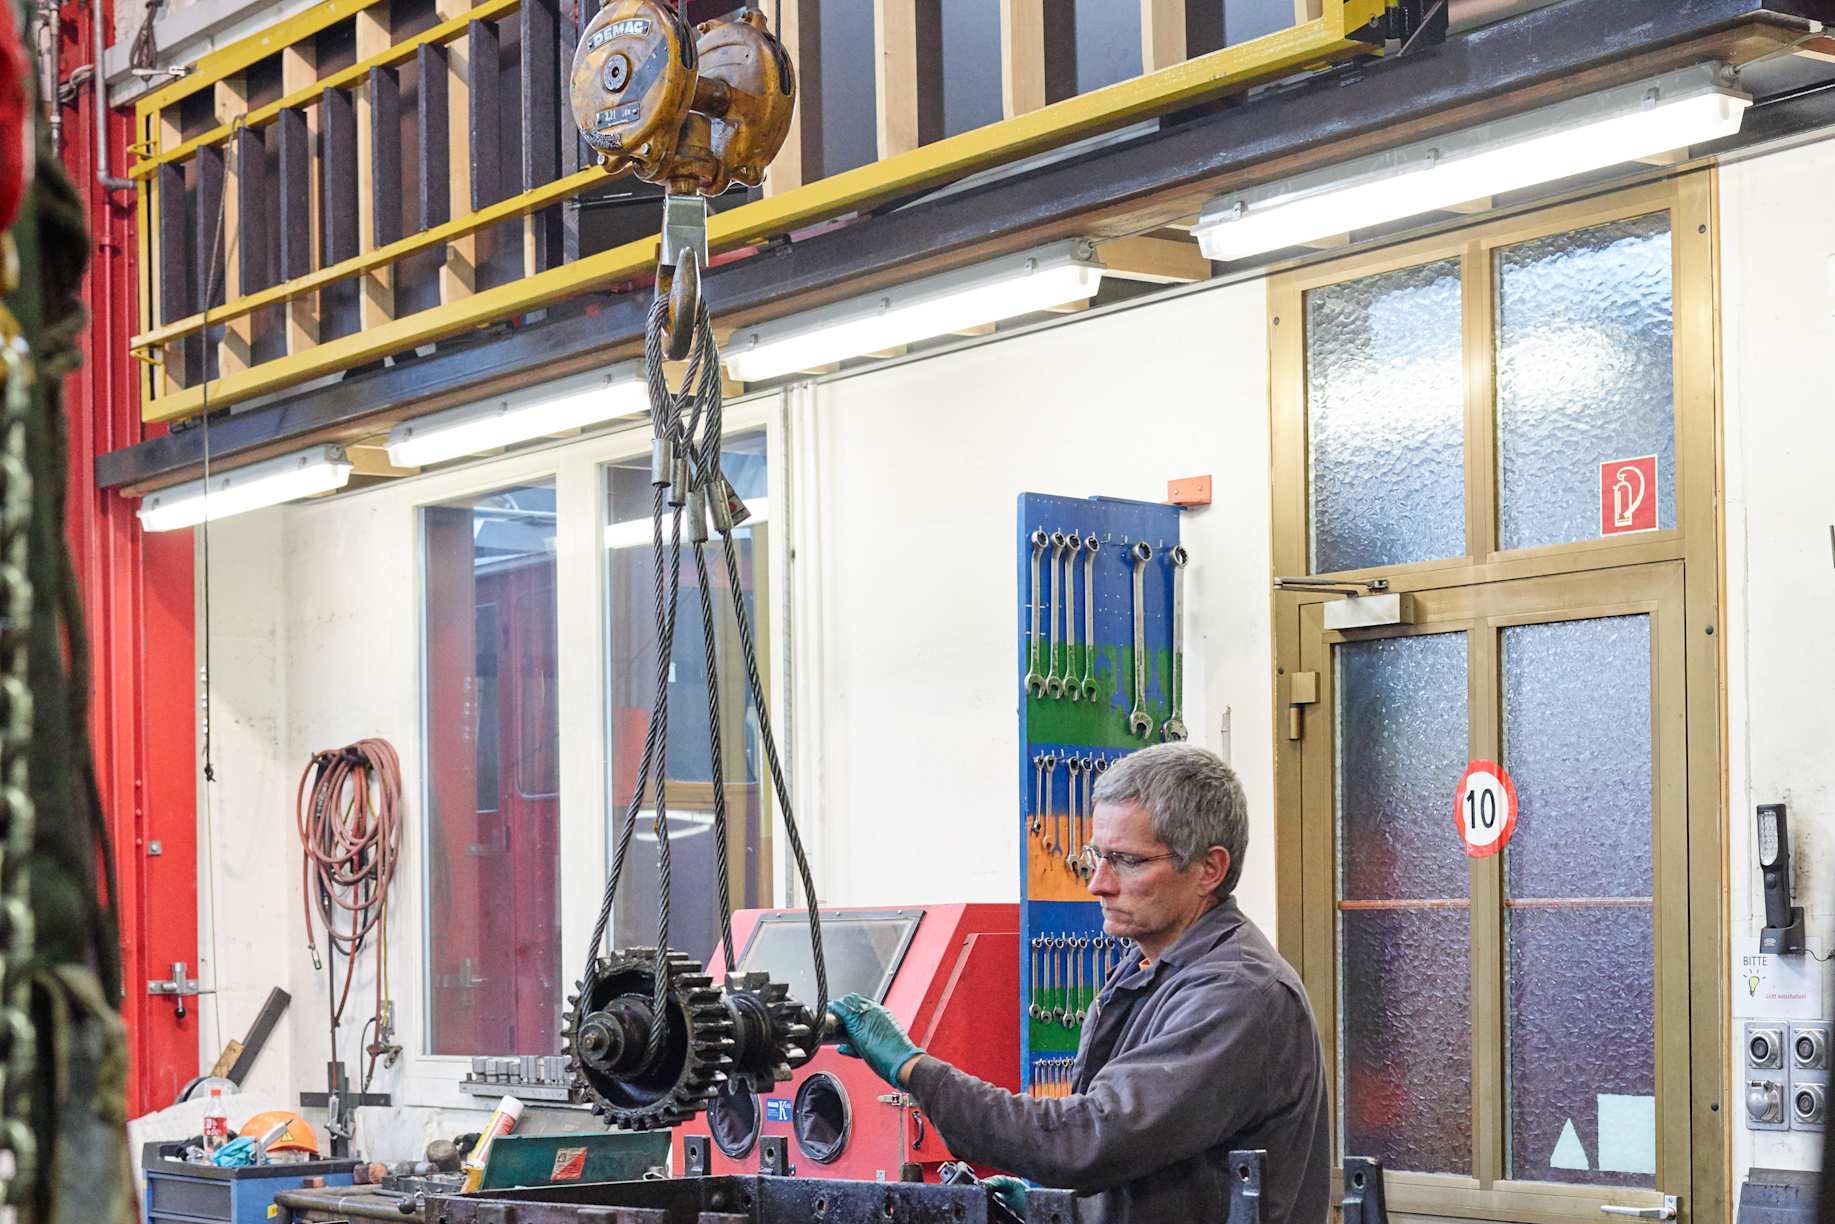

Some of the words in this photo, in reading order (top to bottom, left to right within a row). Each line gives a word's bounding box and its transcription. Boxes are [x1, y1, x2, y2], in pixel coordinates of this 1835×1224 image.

[593, 21, 644, 45] DEMAG
[1466, 788, 1496, 829] 10
[1743, 956, 1768, 966] BITTE
